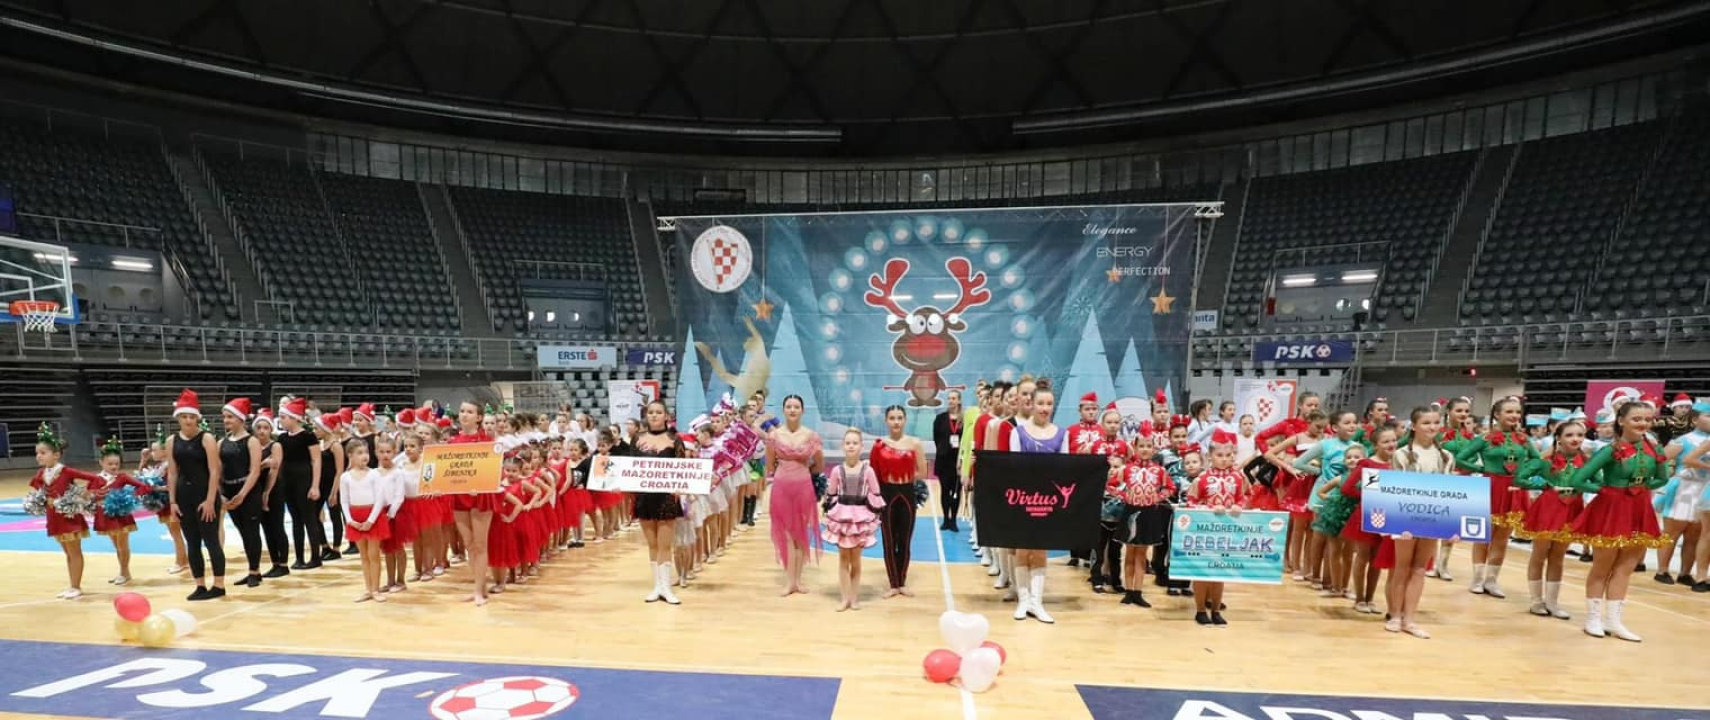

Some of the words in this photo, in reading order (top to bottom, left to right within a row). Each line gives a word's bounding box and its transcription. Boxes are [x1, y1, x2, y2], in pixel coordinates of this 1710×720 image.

[1082, 223, 1137, 237] Elegance
[1096, 245, 1153, 258] ENERGY
[1195, 314, 1215, 322] nta
[558, 351, 586, 360] ERSTE
[643, 351, 676, 364] PSK
[1275, 344, 1316, 360] PSK
[632, 460, 703, 470] PETRINJSKE
[621, 469, 710, 480] MAZORETKINJE
[640, 480, 689, 489] CROATIA
[1005, 488, 1058, 505] Virtus
[1380, 486, 1438, 498] MAŽORETKINJE
[1439, 491, 1468, 500] GRADA
[1398, 502, 1450, 515] VODICA
[1197, 523, 1265, 534] MAŽORETKINJE
[9, 657, 460, 718] PSK
